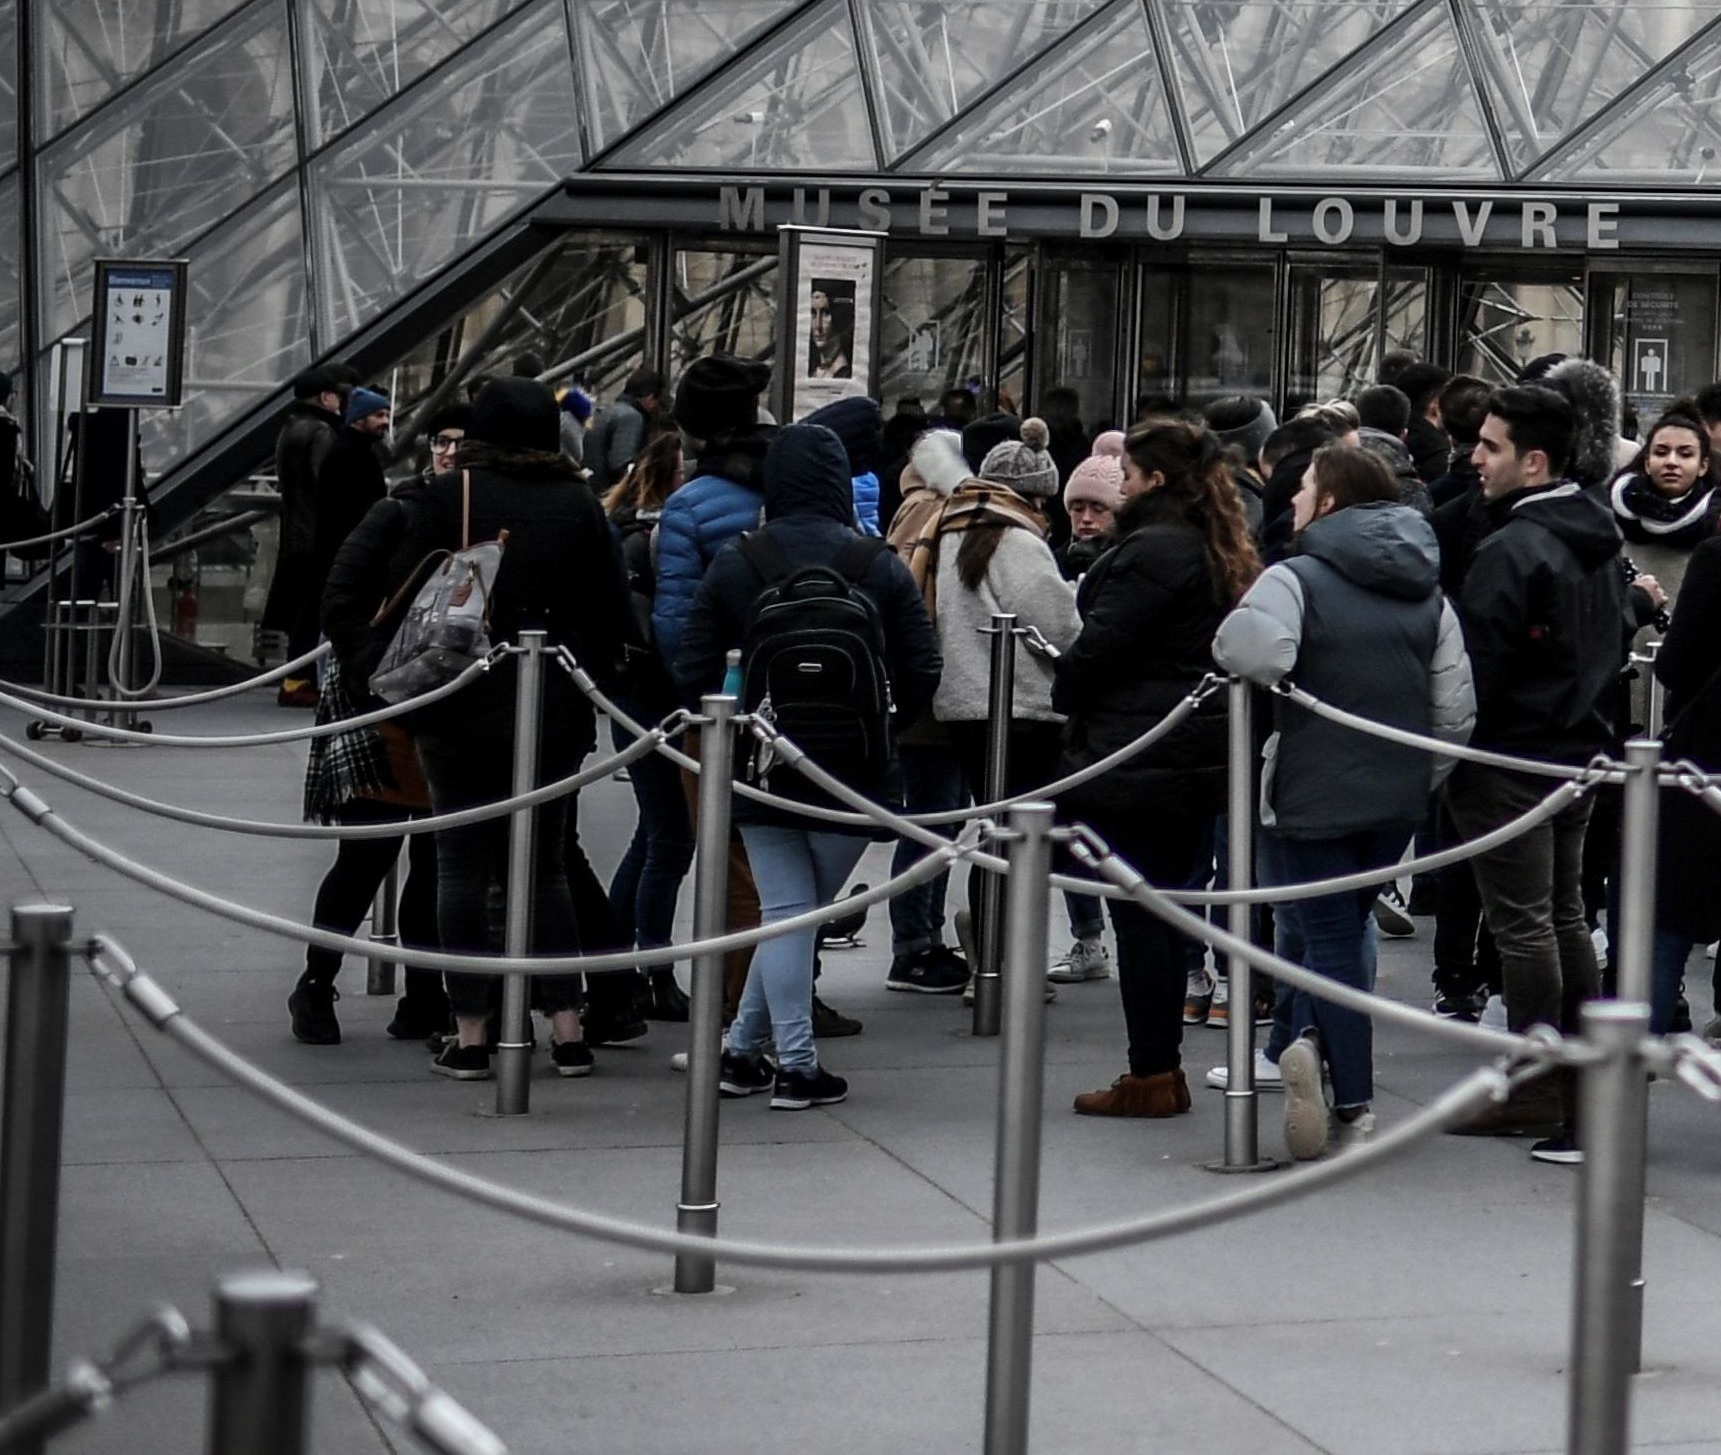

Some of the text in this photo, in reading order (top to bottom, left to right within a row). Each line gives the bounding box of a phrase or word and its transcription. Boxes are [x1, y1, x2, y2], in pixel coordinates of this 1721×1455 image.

[719, 178, 1621, 250] MUSÉE DU LOUVRE
